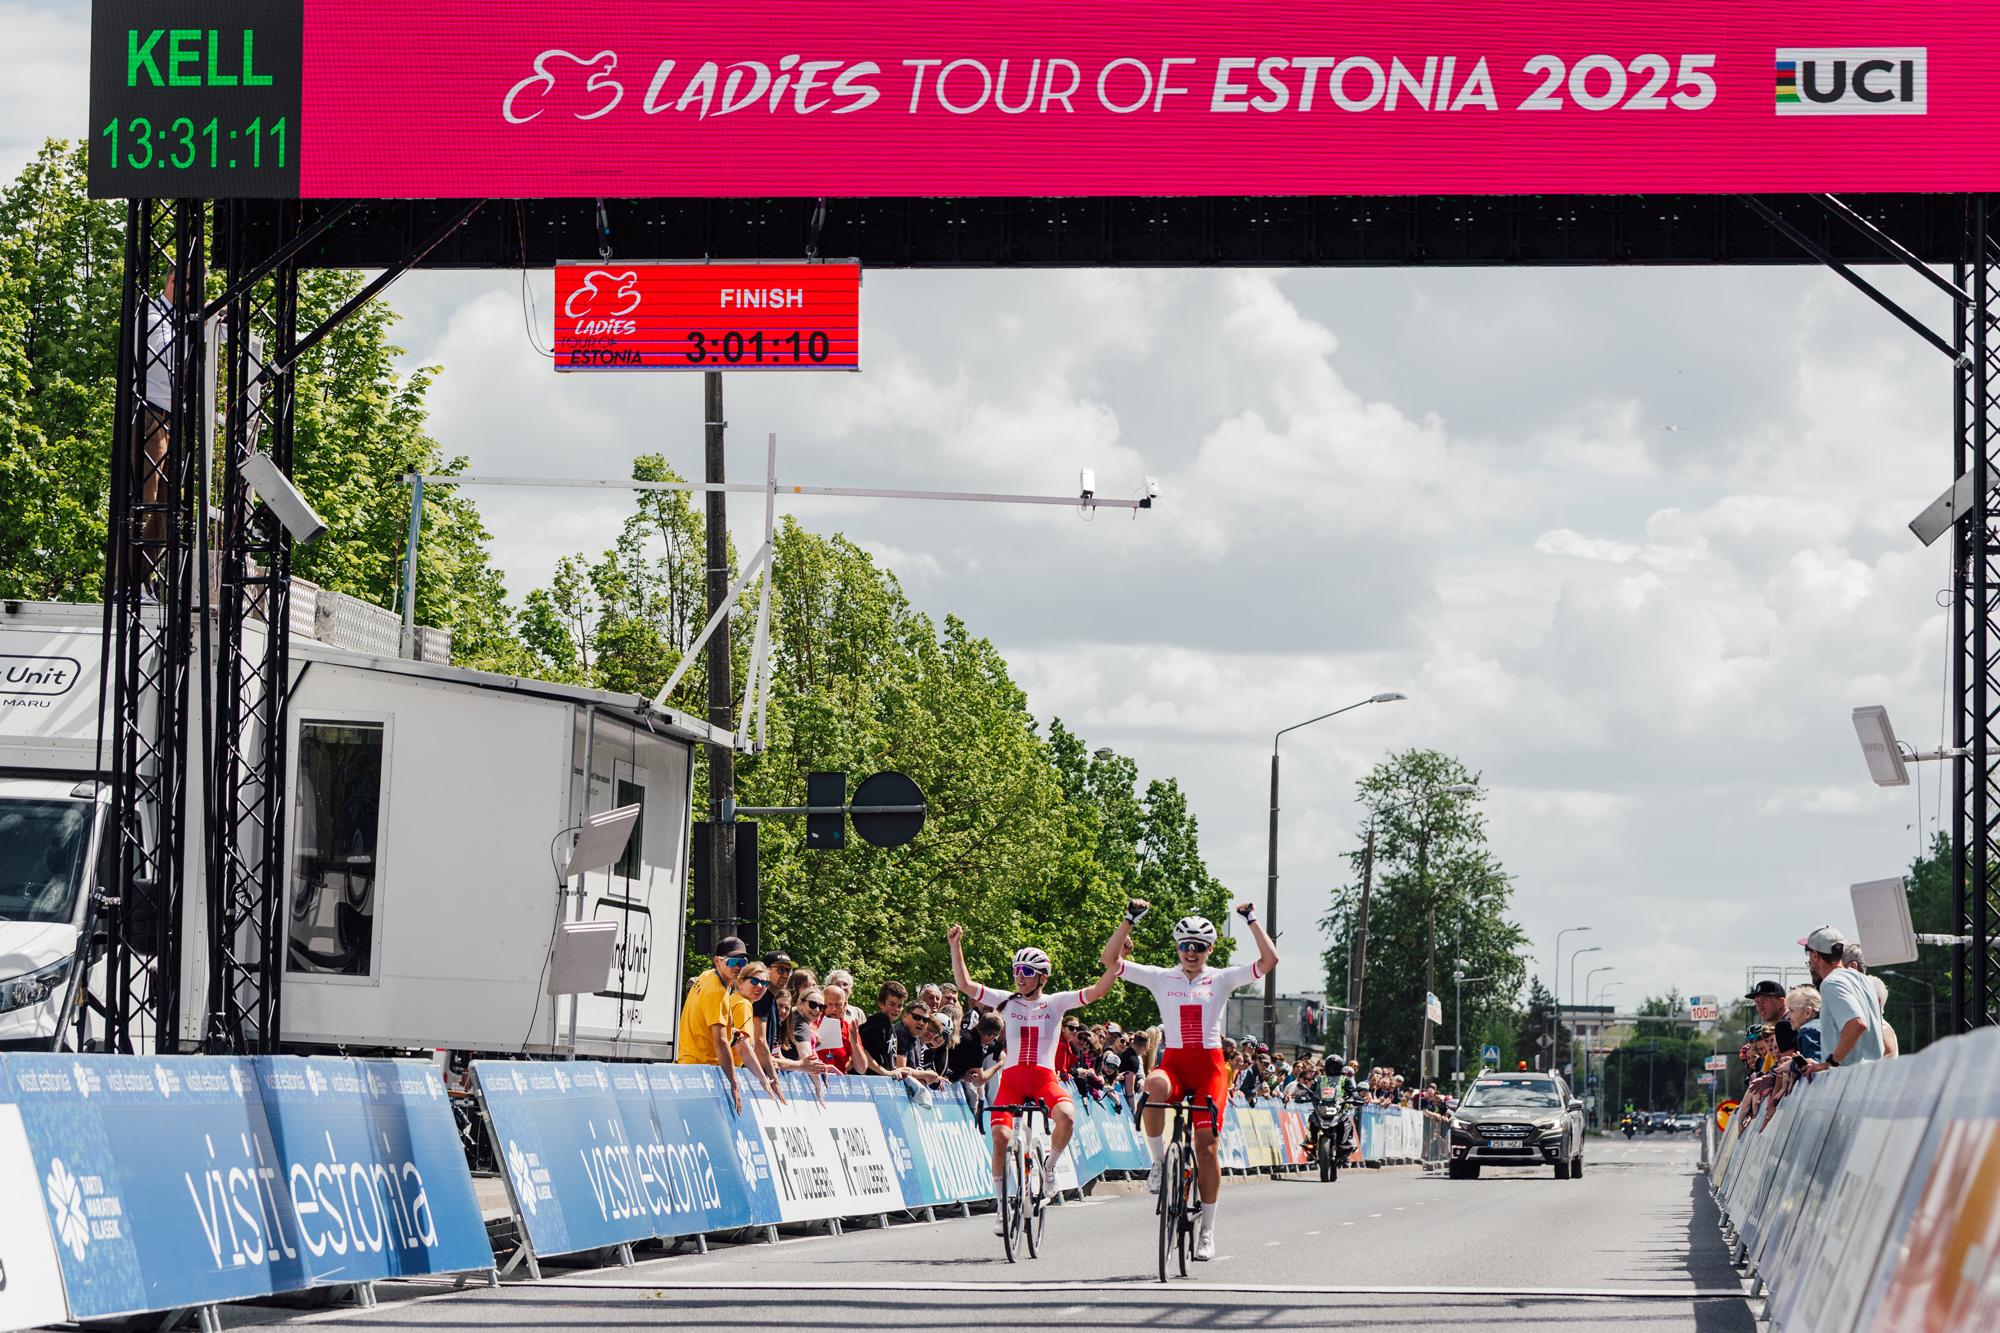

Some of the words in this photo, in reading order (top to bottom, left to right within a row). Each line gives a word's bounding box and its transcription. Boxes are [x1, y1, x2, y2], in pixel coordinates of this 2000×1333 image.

[127, 29, 273, 87] KELL
[902, 57, 1080, 114] TOUR
[1096, 57, 1197, 114] OF
[1209, 55, 1500, 113] ESTONIA
[1516, 53, 1717, 112] 2025
[1801, 58, 1914, 104] UCI
[102, 116, 286, 169] 13:31:11
[720, 288, 804, 309] FINISH
[560, 336, 598, 348] TOUR
[685, 331, 829, 363] 3:01:10
[570, 349, 643, 365] ESTONIA
[6, 666, 67, 685] Unit
[2, 699, 51, 708] MARU
[627, 933, 648, 974] Unit
[1010, 1012, 1051, 1021] POLSKA
[781, 1126, 808, 1159] RAND
[580, 1119, 647, 1223] visit
[636, 1118, 721, 1218] estonia
[79, 1175, 104, 1195] TARTU
[85, 1197, 122, 1217] MARATON
[185, 1133, 297, 1270] visit
[290, 1130, 439, 1258] estonia
[90, 1219, 122, 1240] KLASSIK
